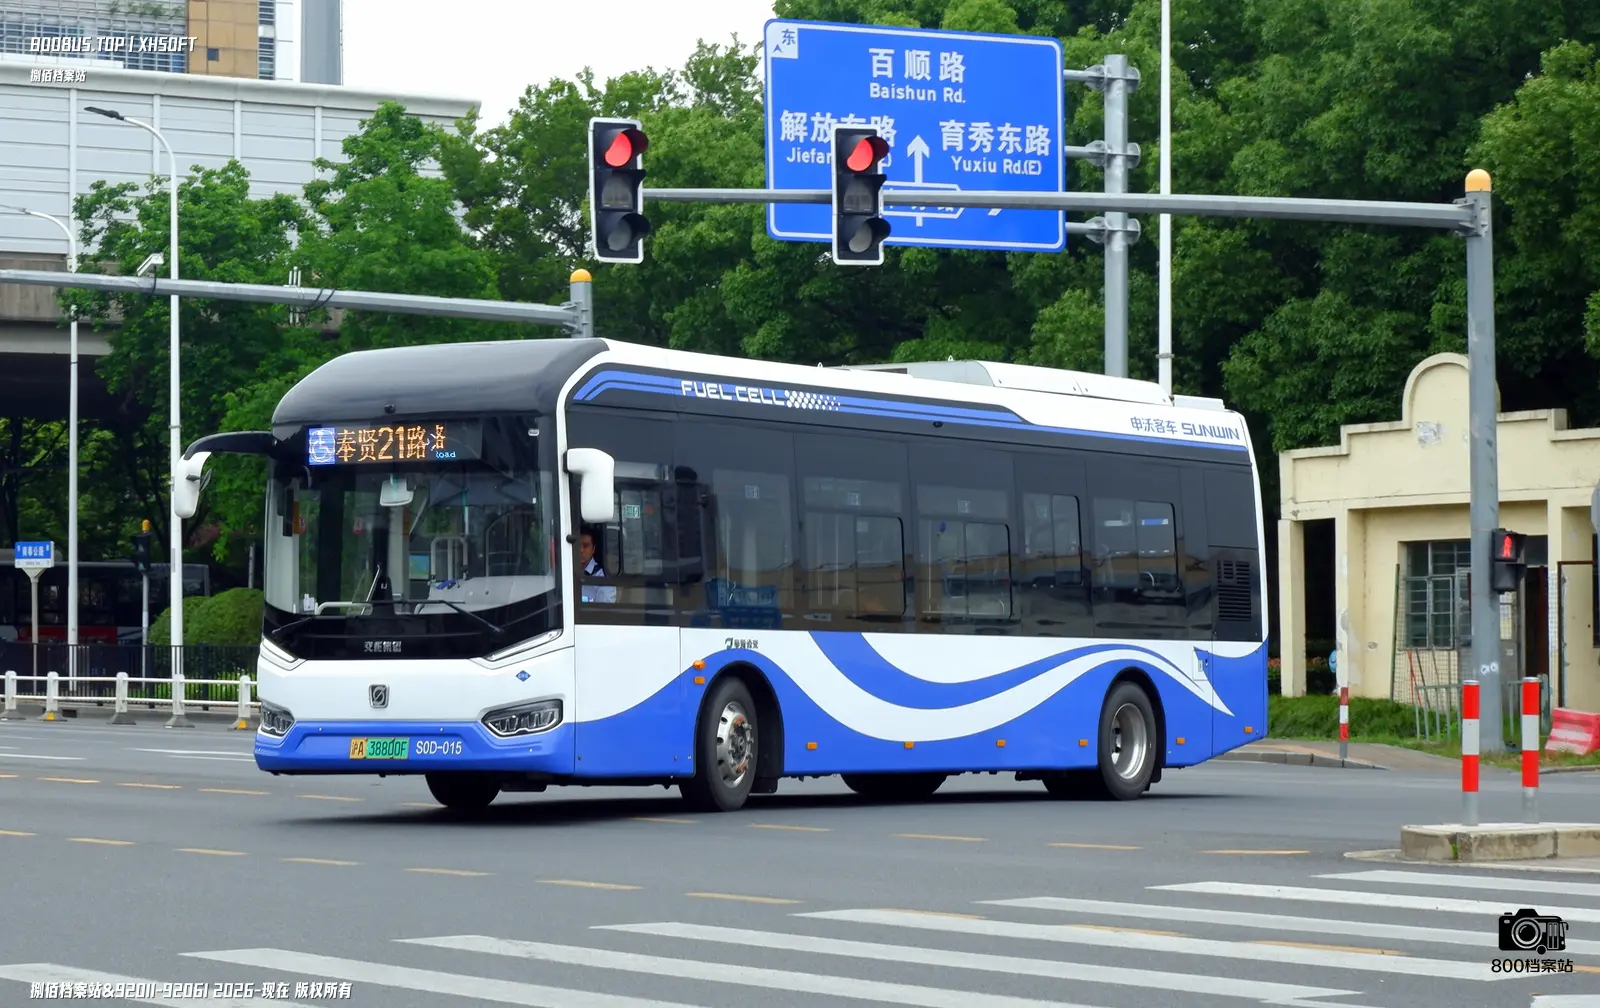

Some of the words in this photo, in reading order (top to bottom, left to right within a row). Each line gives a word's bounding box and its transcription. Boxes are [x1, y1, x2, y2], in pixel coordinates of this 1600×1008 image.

[781, 29, 796, 45] 东
[869, 48, 966, 83] 百顺路
[869, 83, 936, 102] Baishun
[943, 87, 966, 103] Rd.
[939, 119, 1051, 156] 育秀东路
[951, 156, 997, 173] Yuxiu
[1003, 158, 1042, 176] Rd.(E)
[681, 380, 732, 400] FUEL
[735, 386, 785, 406] CELL
[1130, 416, 1178, 435] 申沃客车
[1181, 422, 1240, 440] SUNWIN
